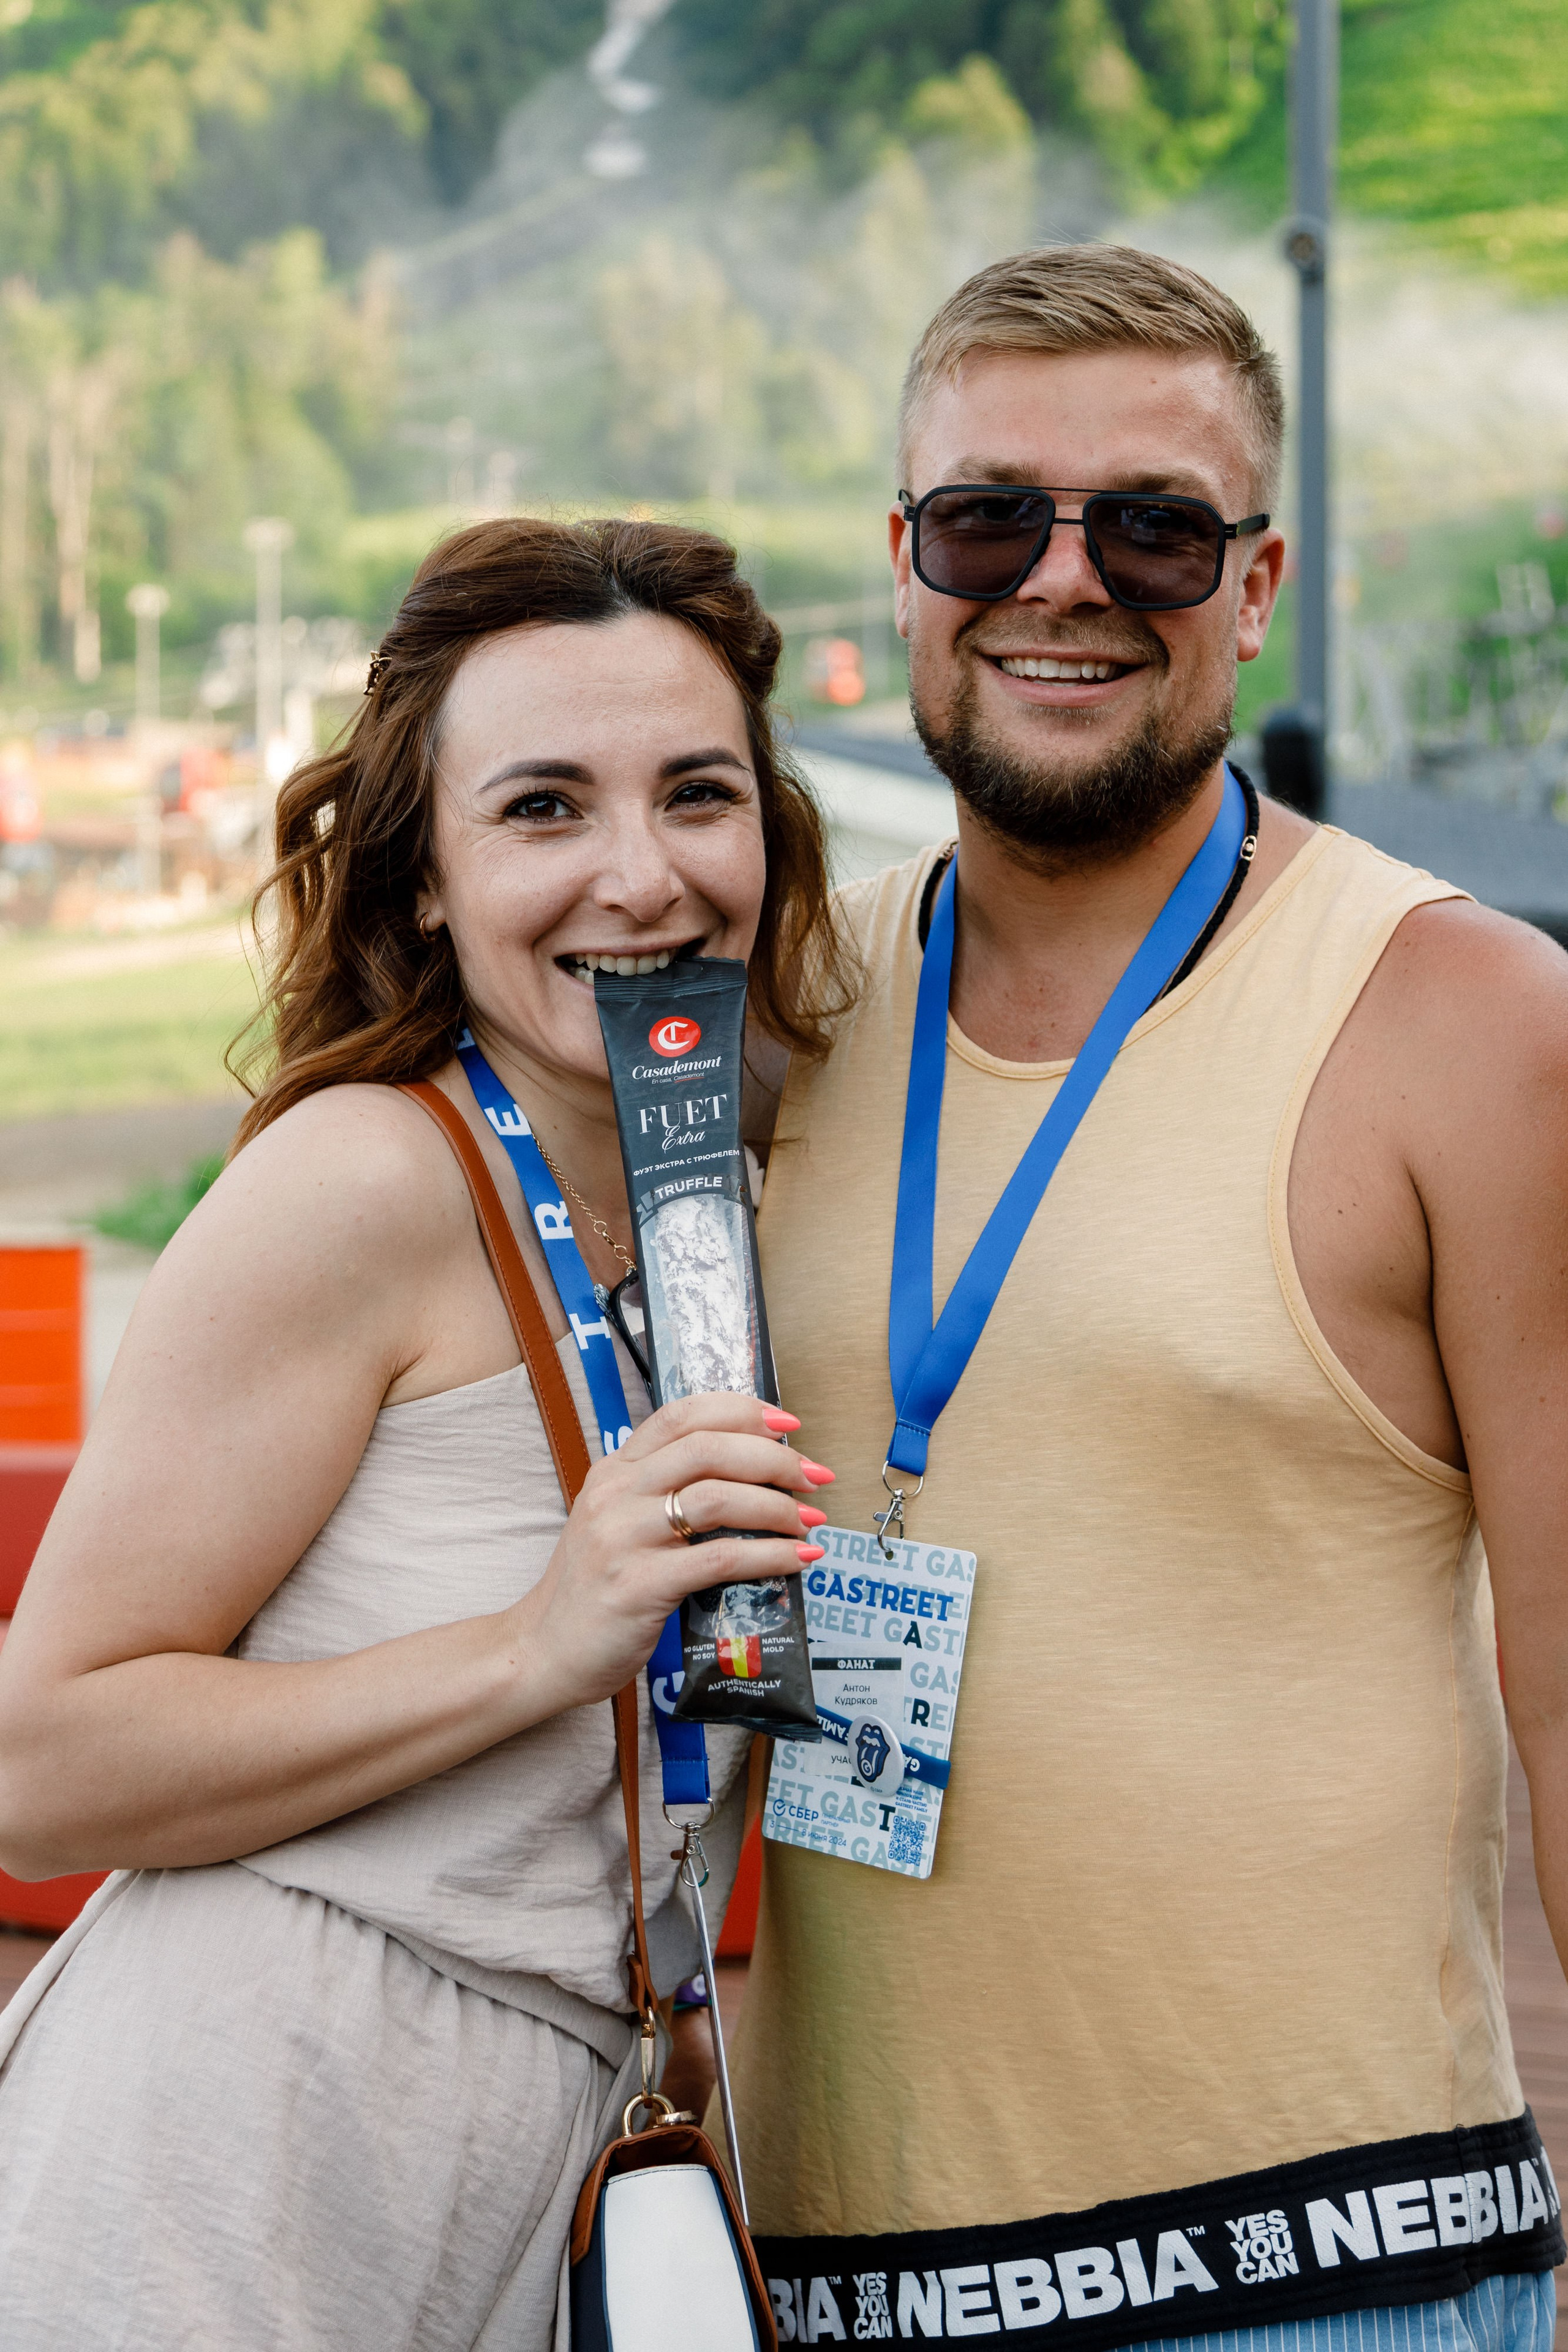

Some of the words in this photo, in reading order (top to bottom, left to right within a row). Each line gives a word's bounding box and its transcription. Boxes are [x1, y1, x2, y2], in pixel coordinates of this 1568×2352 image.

[632, 1055, 722, 1080] Casademont
[673, 1072, 704, 1082] Casademont
[637, 1094, 727, 1134] FUET
[662, 1125, 706, 1154] Extra
[633, 1166, 654, 1176] ФУЭТ
[655, 1159, 685, 1170] ЭКСТРА
[693, 1150, 740, 1163] ТРЮФЕЛЕМ
[655, 1176, 723, 1199] TRUFFLE
[806, 1529, 920, 1572] STREET
[807, 1570, 954, 1622] GASTREET
[804, 1599, 877, 1638] REET
[884, 1617, 965, 1657] GAST
[692, 1643, 715, 1652] GLUTEN
[837, 1659, 875, 1670] ФАНАТ
[707, 1679, 781, 1692] AUTHENTICALLY
[727, 1686, 764, 1697] SPANISH
[843, 1684, 870, 1692] Антон
[835, 1696, 878, 1706] Кудряков
[831, 1755, 851, 1764] УЧА
[788, 1805, 818, 1822] СБЕР
[808, 1832, 827, 1841] июня
[829, 1835, 846, 1847] 2024
[1225, 2209, 1289, 2242] YES
[1230, 2230, 1294, 2263] YOU
[1236, 2252, 1300, 2285] CAN
[852, 2271, 888, 2297] YES
[856, 2294, 889, 2318] YOU
[853, 2316, 893, 2340] CAN
